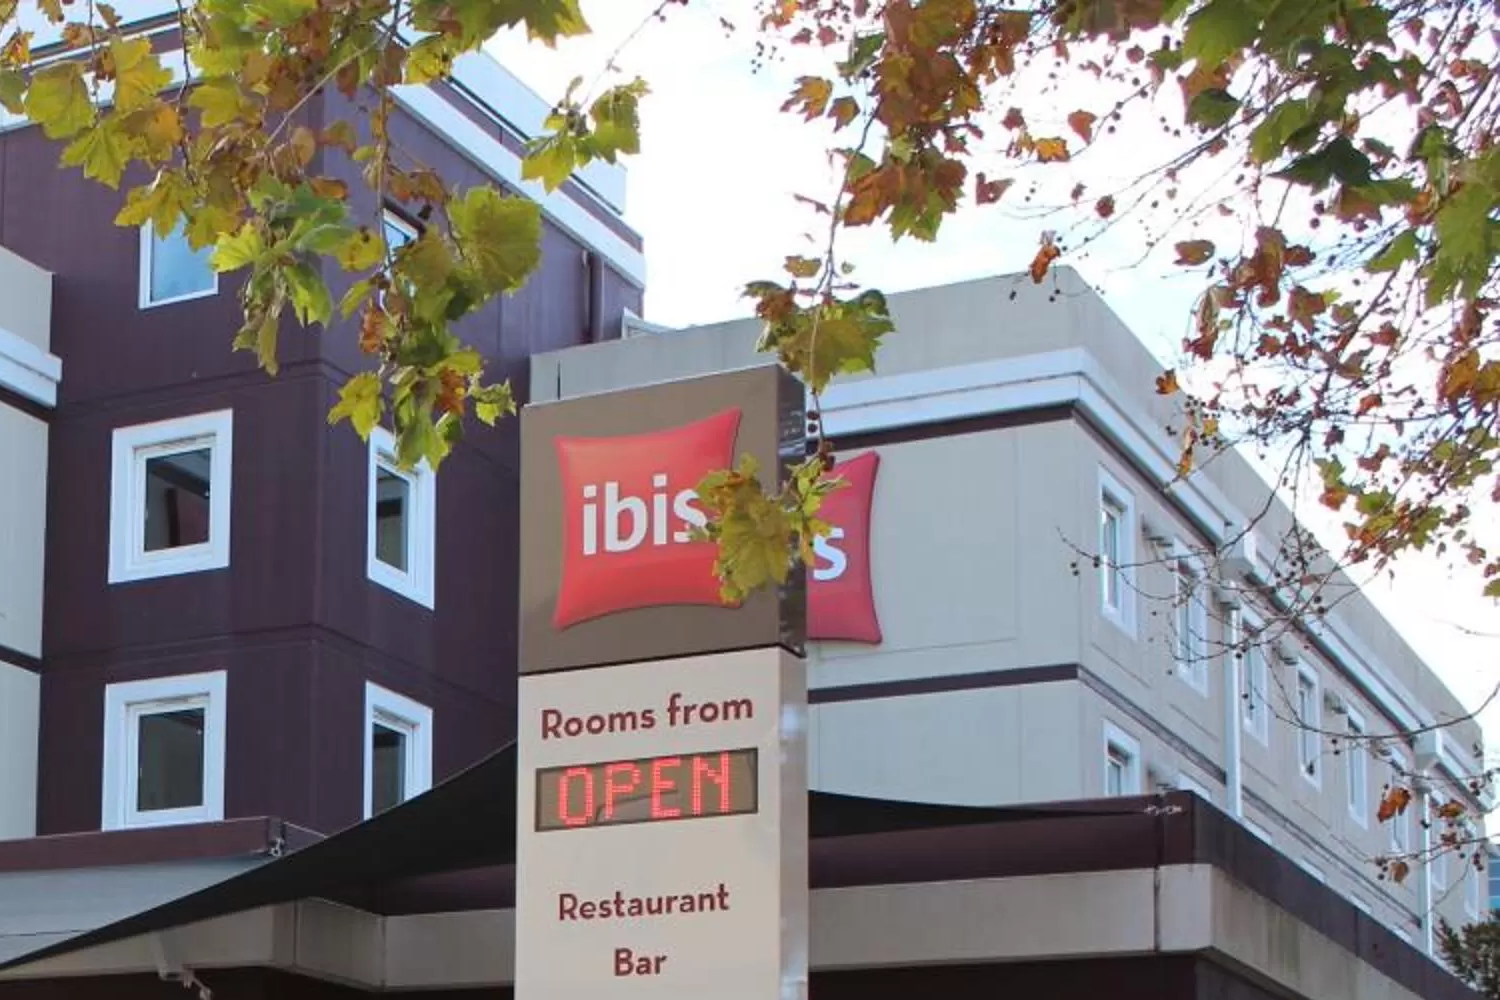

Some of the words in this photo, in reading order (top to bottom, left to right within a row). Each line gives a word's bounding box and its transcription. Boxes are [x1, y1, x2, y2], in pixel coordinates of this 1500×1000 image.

[583, 473, 709, 556] ibis
[541, 708, 656, 740] Rooms
[667, 692, 753, 727] from
[558, 750, 731, 827] OPEN
[558, 883, 730, 921] Restaurant
[613, 947, 667, 977] Bar
